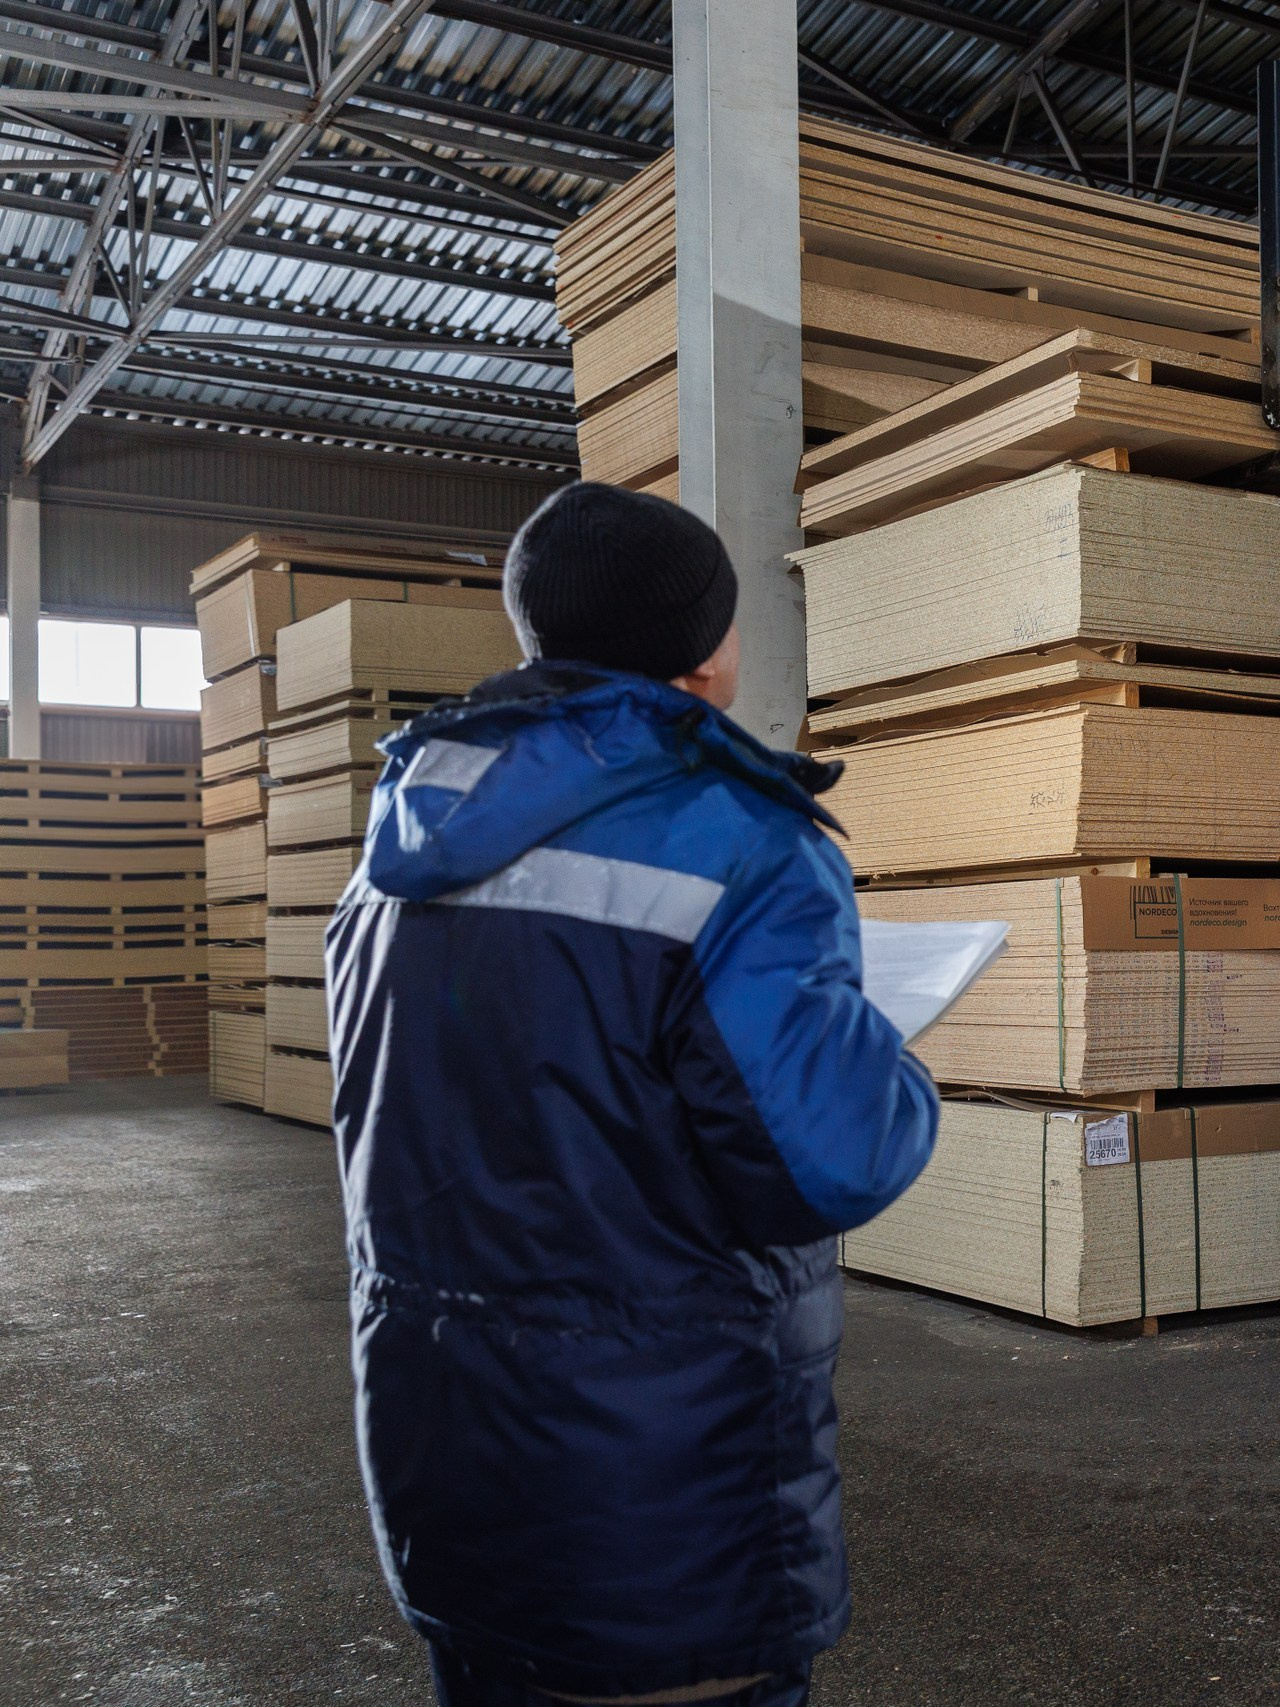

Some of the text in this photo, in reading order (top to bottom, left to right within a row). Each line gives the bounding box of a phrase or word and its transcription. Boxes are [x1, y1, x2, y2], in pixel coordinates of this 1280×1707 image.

[1188, 897, 1249, 907] Источник вашего
[1138, 907, 1178, 917] NORDECO
[1189, 908, 1237, 917] вдохновения!
[1189, 918, 1248, 928] nordeco.design
[1089, 1148, 1117, 1160] 25670
